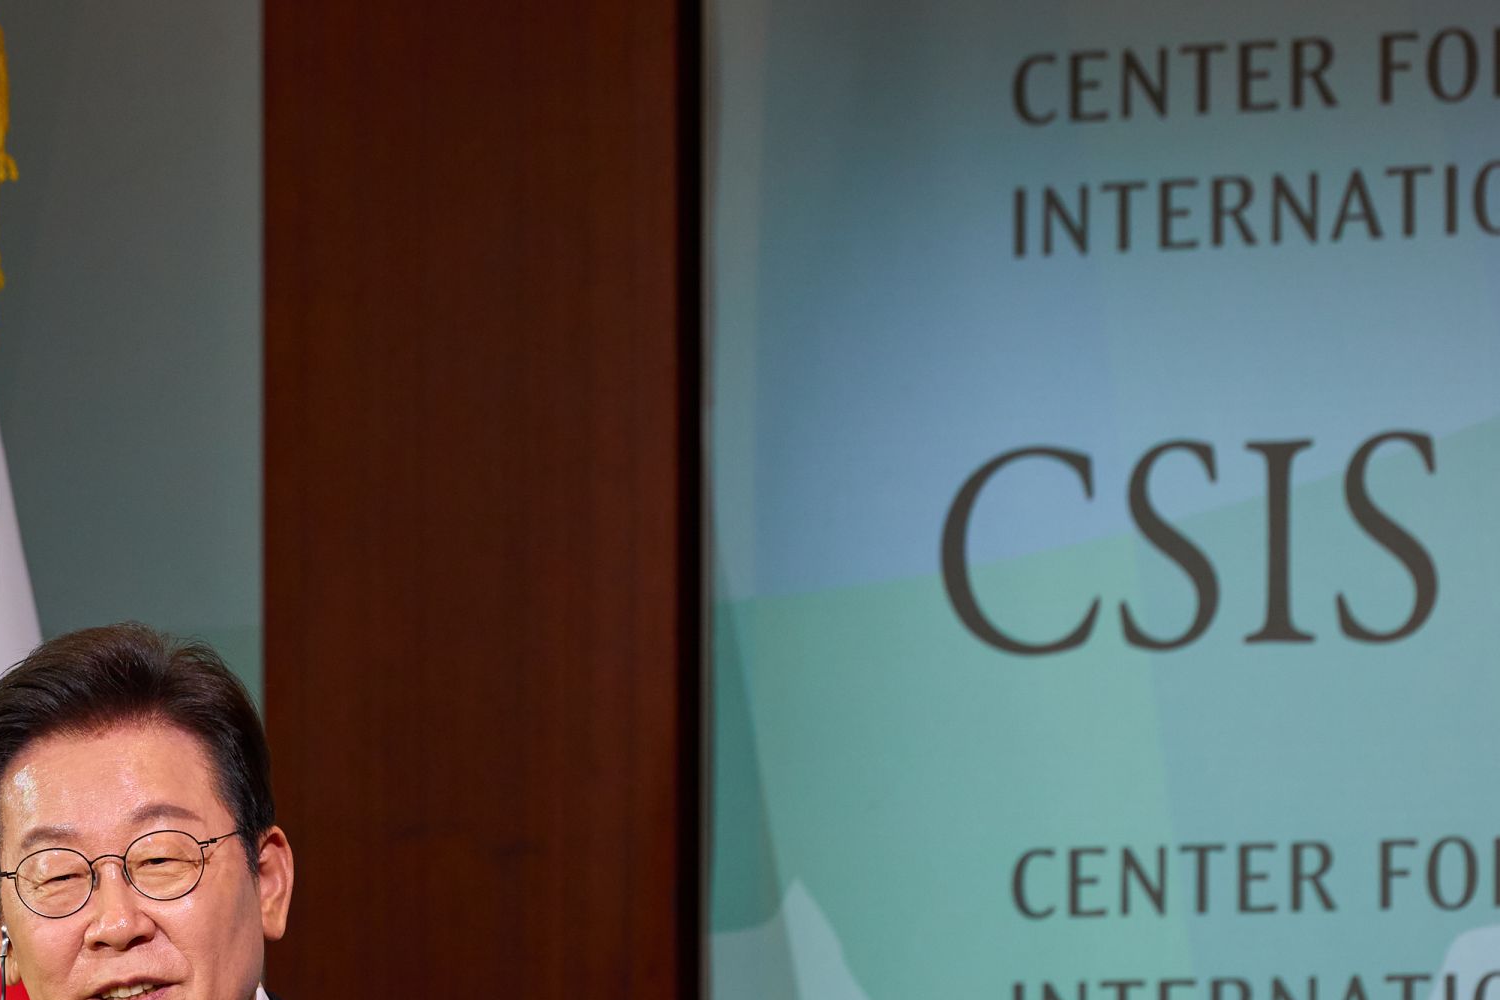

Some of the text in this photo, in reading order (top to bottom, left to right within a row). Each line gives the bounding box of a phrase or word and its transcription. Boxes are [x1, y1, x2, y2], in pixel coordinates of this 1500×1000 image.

[1011, 26, 1500, 127] CENTER FO
[940, 430, 1439, 657] CSIS
[1010, 835, 1500, 920] CENTER FO
